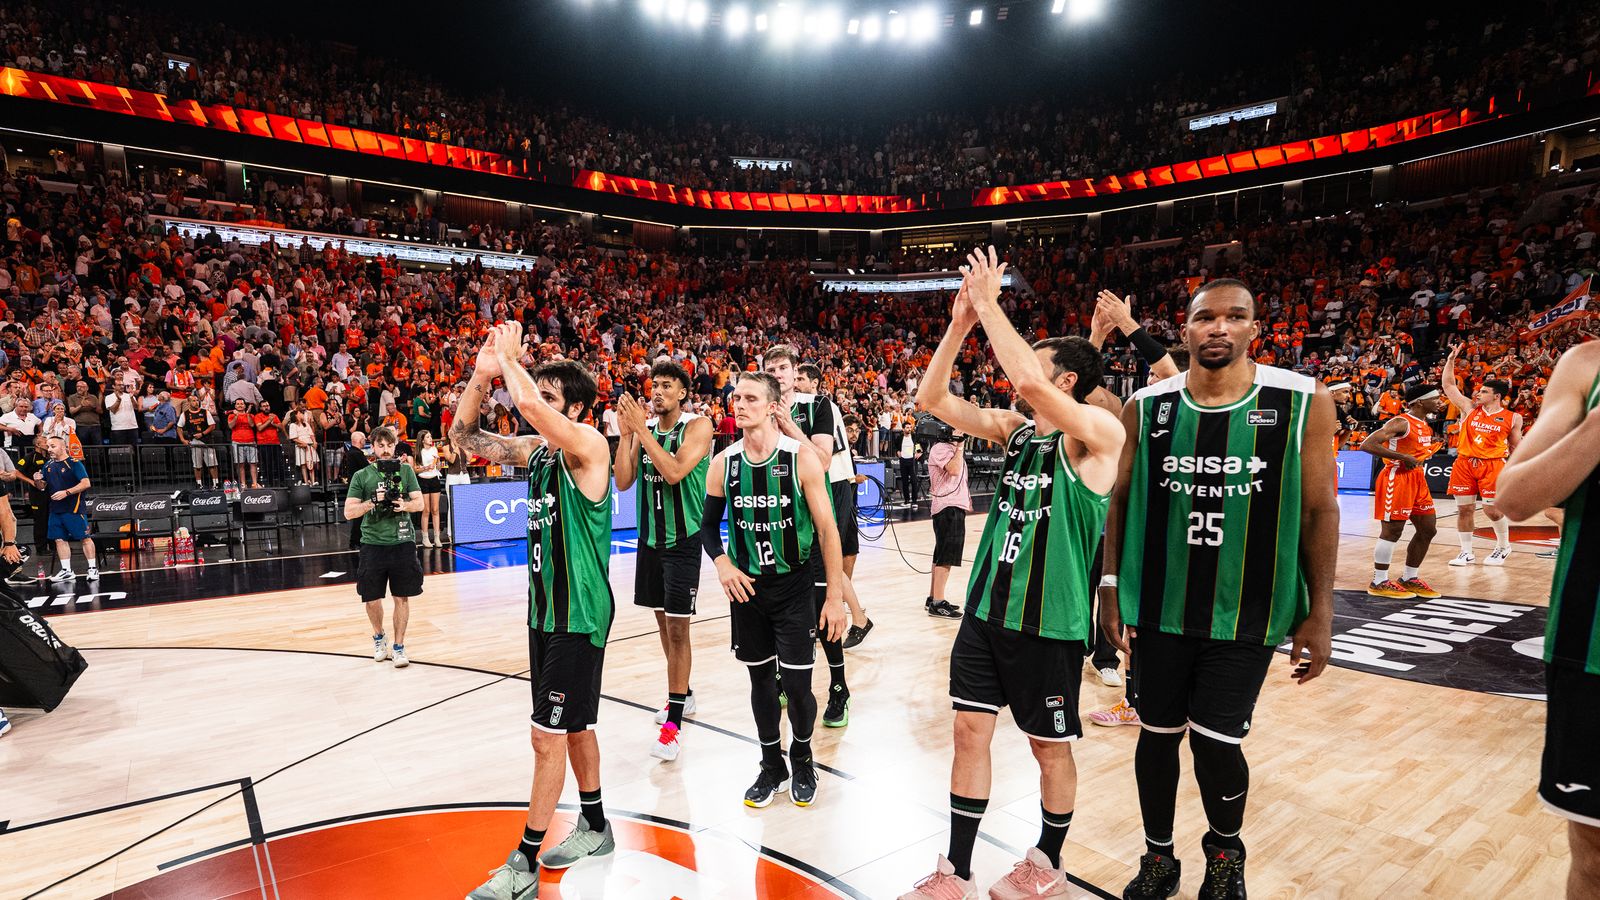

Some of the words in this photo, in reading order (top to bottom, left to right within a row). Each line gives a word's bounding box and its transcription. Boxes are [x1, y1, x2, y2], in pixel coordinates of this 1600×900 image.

[1474, 434, 1483, 445] 4
[1162, 456, 1242, 474] asisa
[1160, 478, 1263, 497] JOVENTUT
[656, 490, 662, 510] 1
[733, 495, 778, 508] asisa
[1187, 511, 1225, 546] 25
[532, 543, 541, 572] 9
[755, 541, 775, 566] 12
[998, 531, 1022, 564] 16
